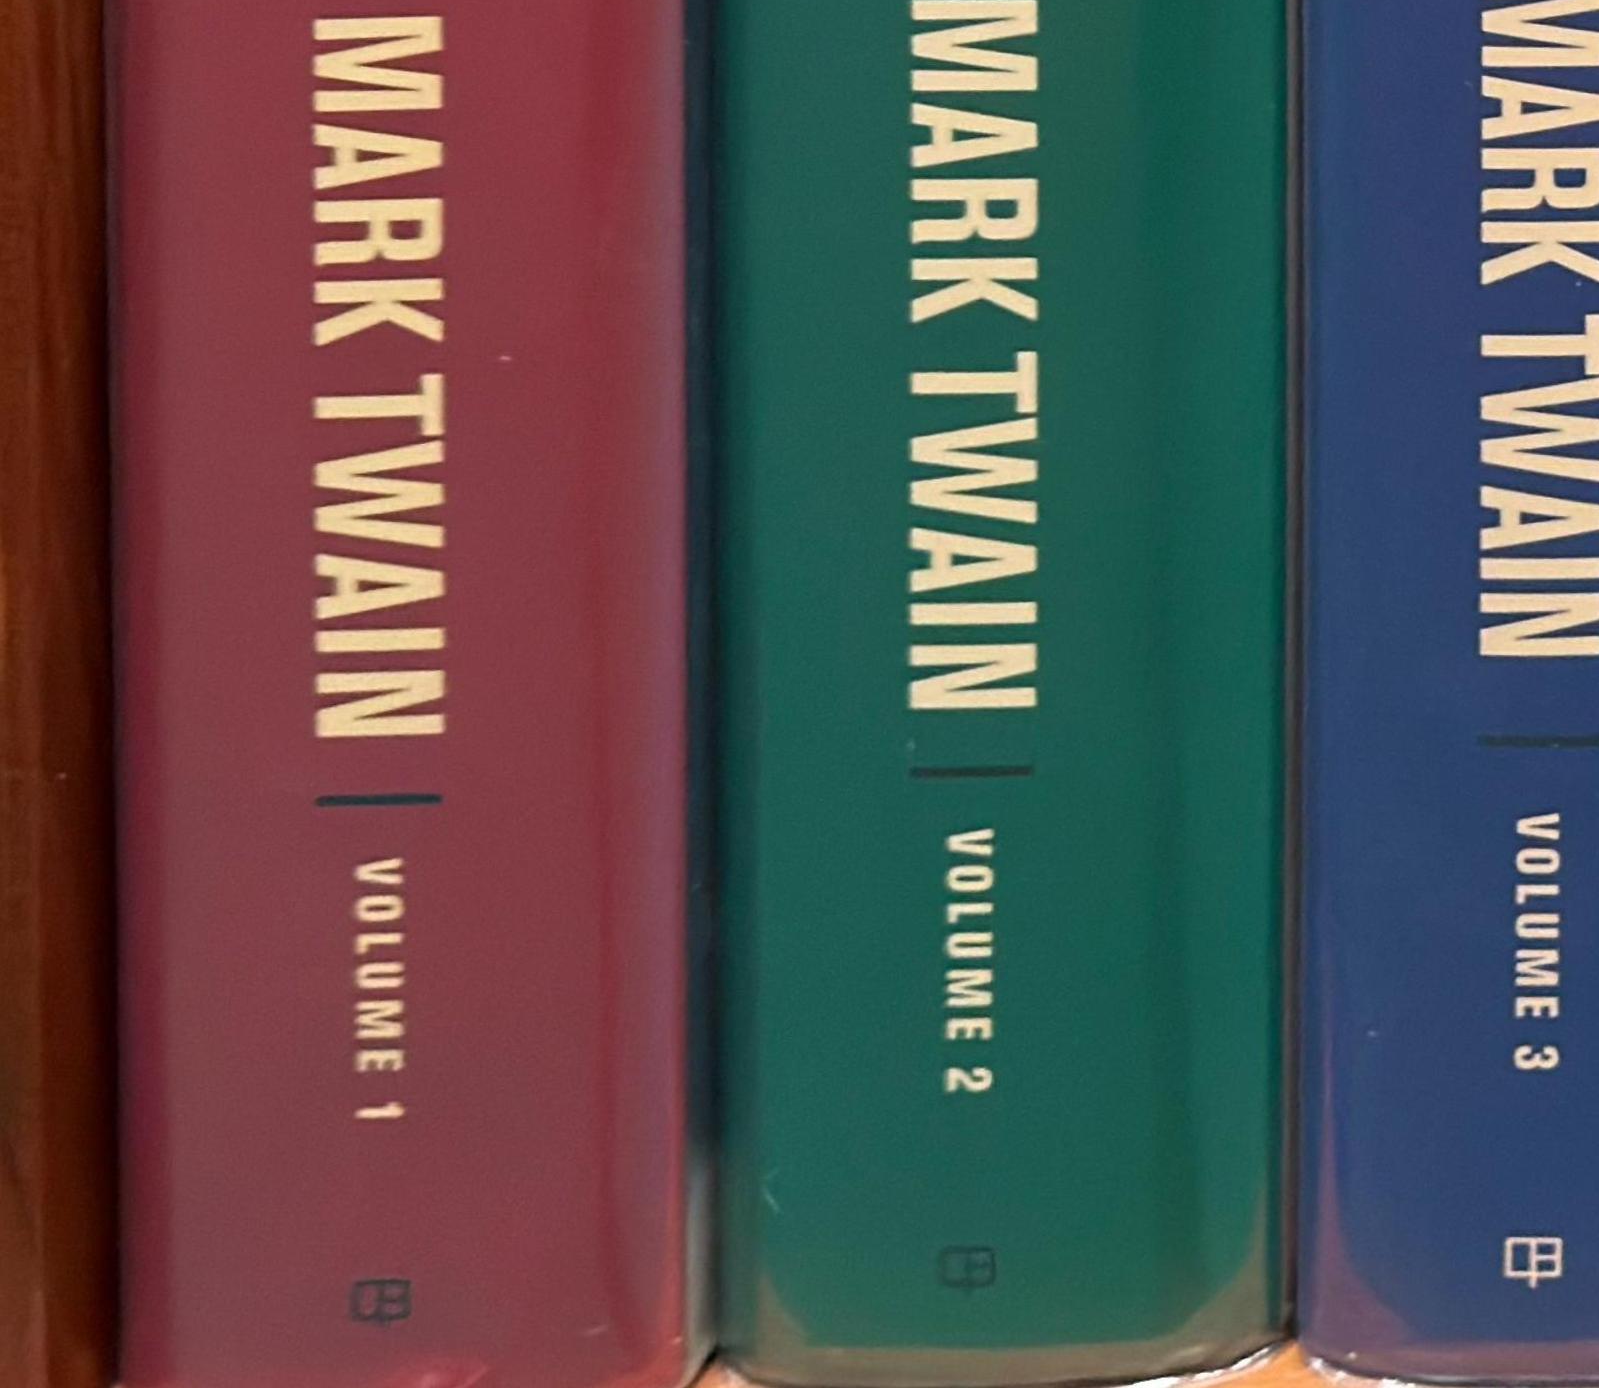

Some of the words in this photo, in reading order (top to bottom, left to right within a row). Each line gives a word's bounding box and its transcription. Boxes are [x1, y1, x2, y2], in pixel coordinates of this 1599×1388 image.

[313, 16, 445, 343] MARK
[315, 375, 445, 739] TWAIN
[909, 352, 1039, 710] TWAIN
[352, 856, 404, 1072] VOLUME
[944, 828, 995, 1044] VOLUME
[1512, 811, 1561, 1022] VOLUME
[356, 1101, 403, 1122] 1
[946, 1064, 993, 1095] 2
[1512, 1044, 1559, 1074] 3
